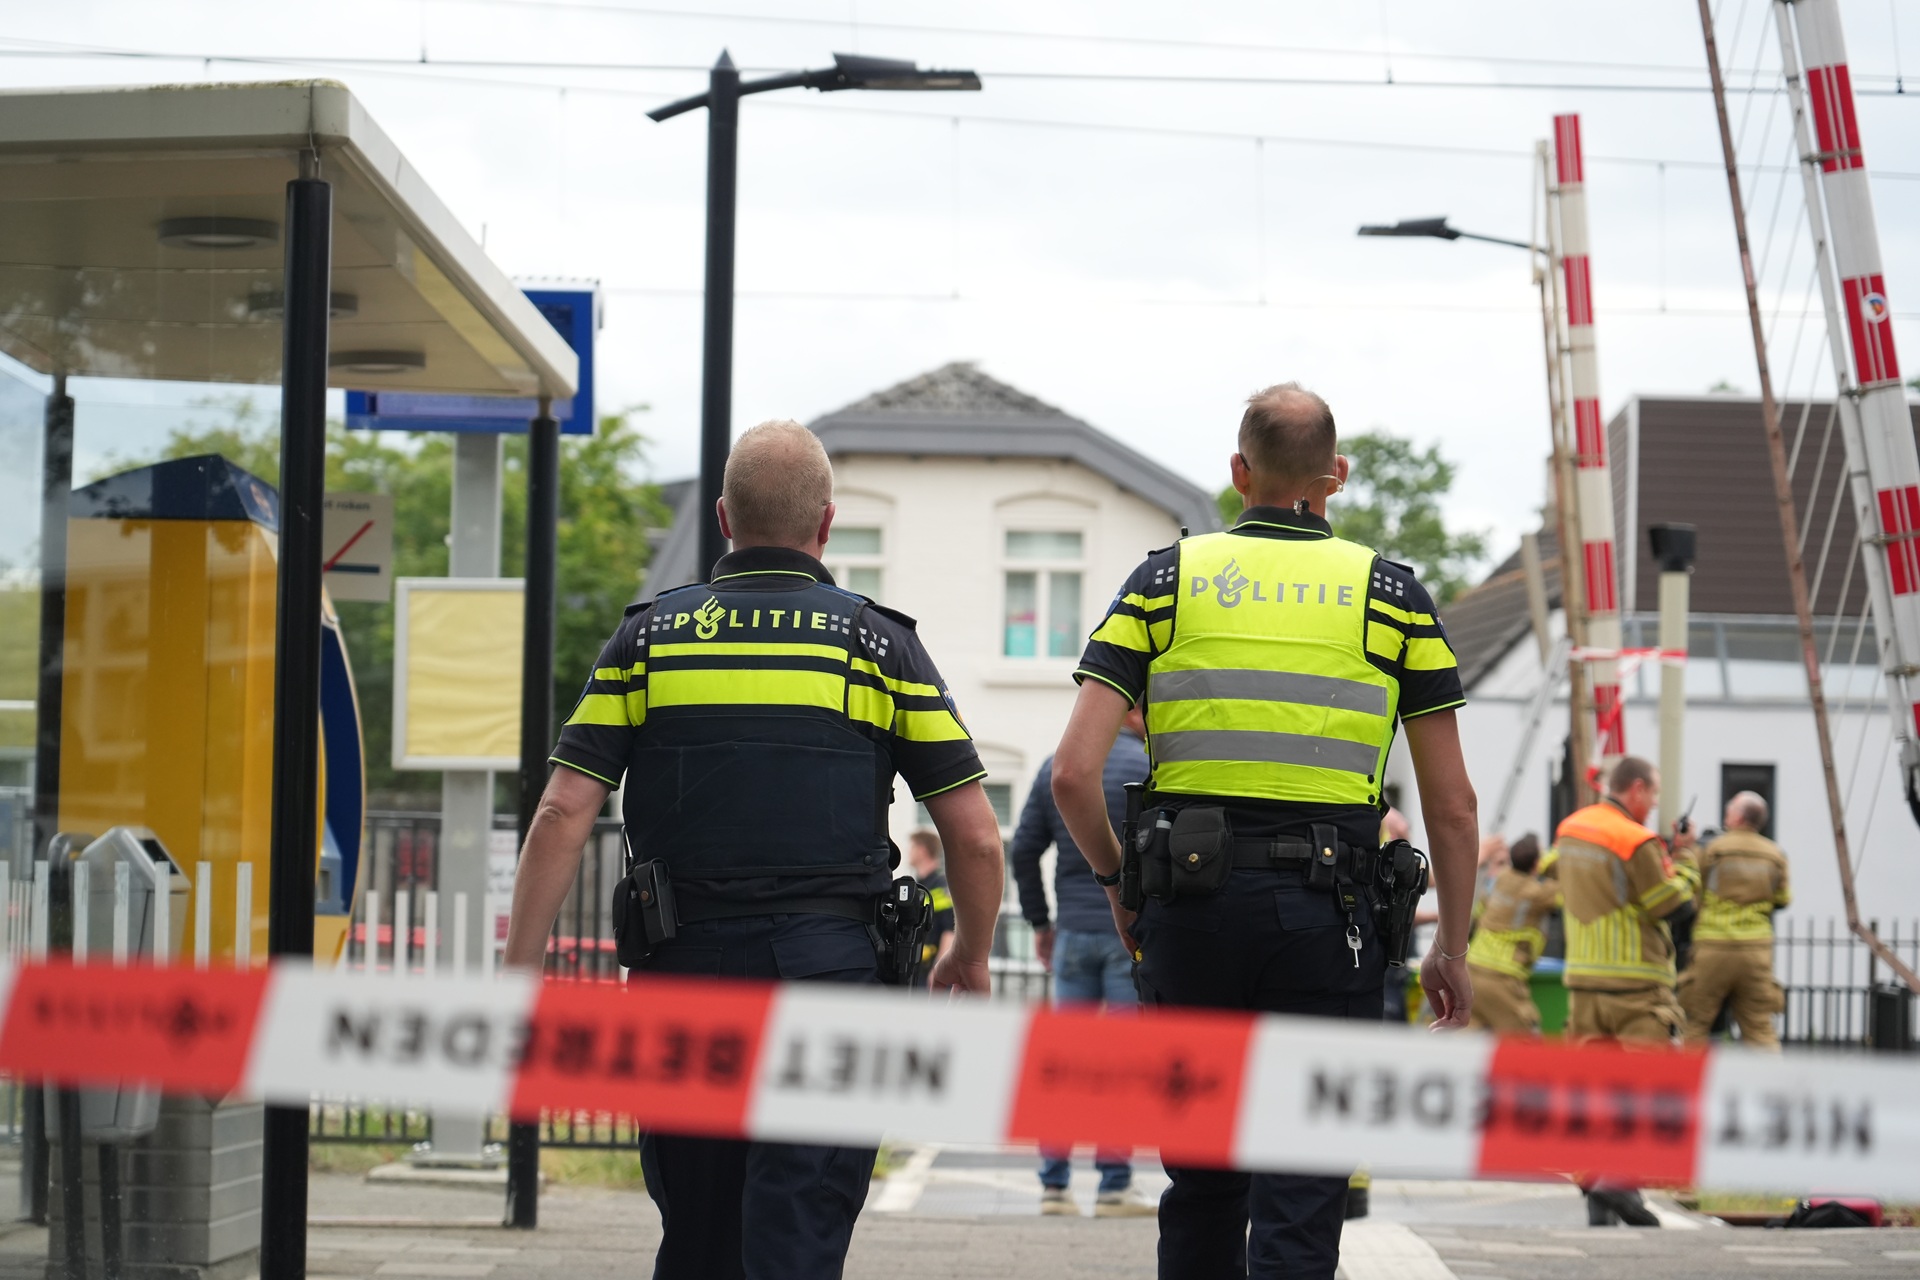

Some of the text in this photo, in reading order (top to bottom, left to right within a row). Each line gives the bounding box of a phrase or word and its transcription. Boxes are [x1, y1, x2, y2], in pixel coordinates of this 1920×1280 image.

[1190, 557, 1353, 609] POLITIE
[673, 595, 828, 640] POLITIE
[326, 1008, 750, 1086] BETREDEN
[776, 1030, 953, 1104] NIET
[1714, 1090, 1873, 1157] NIET
